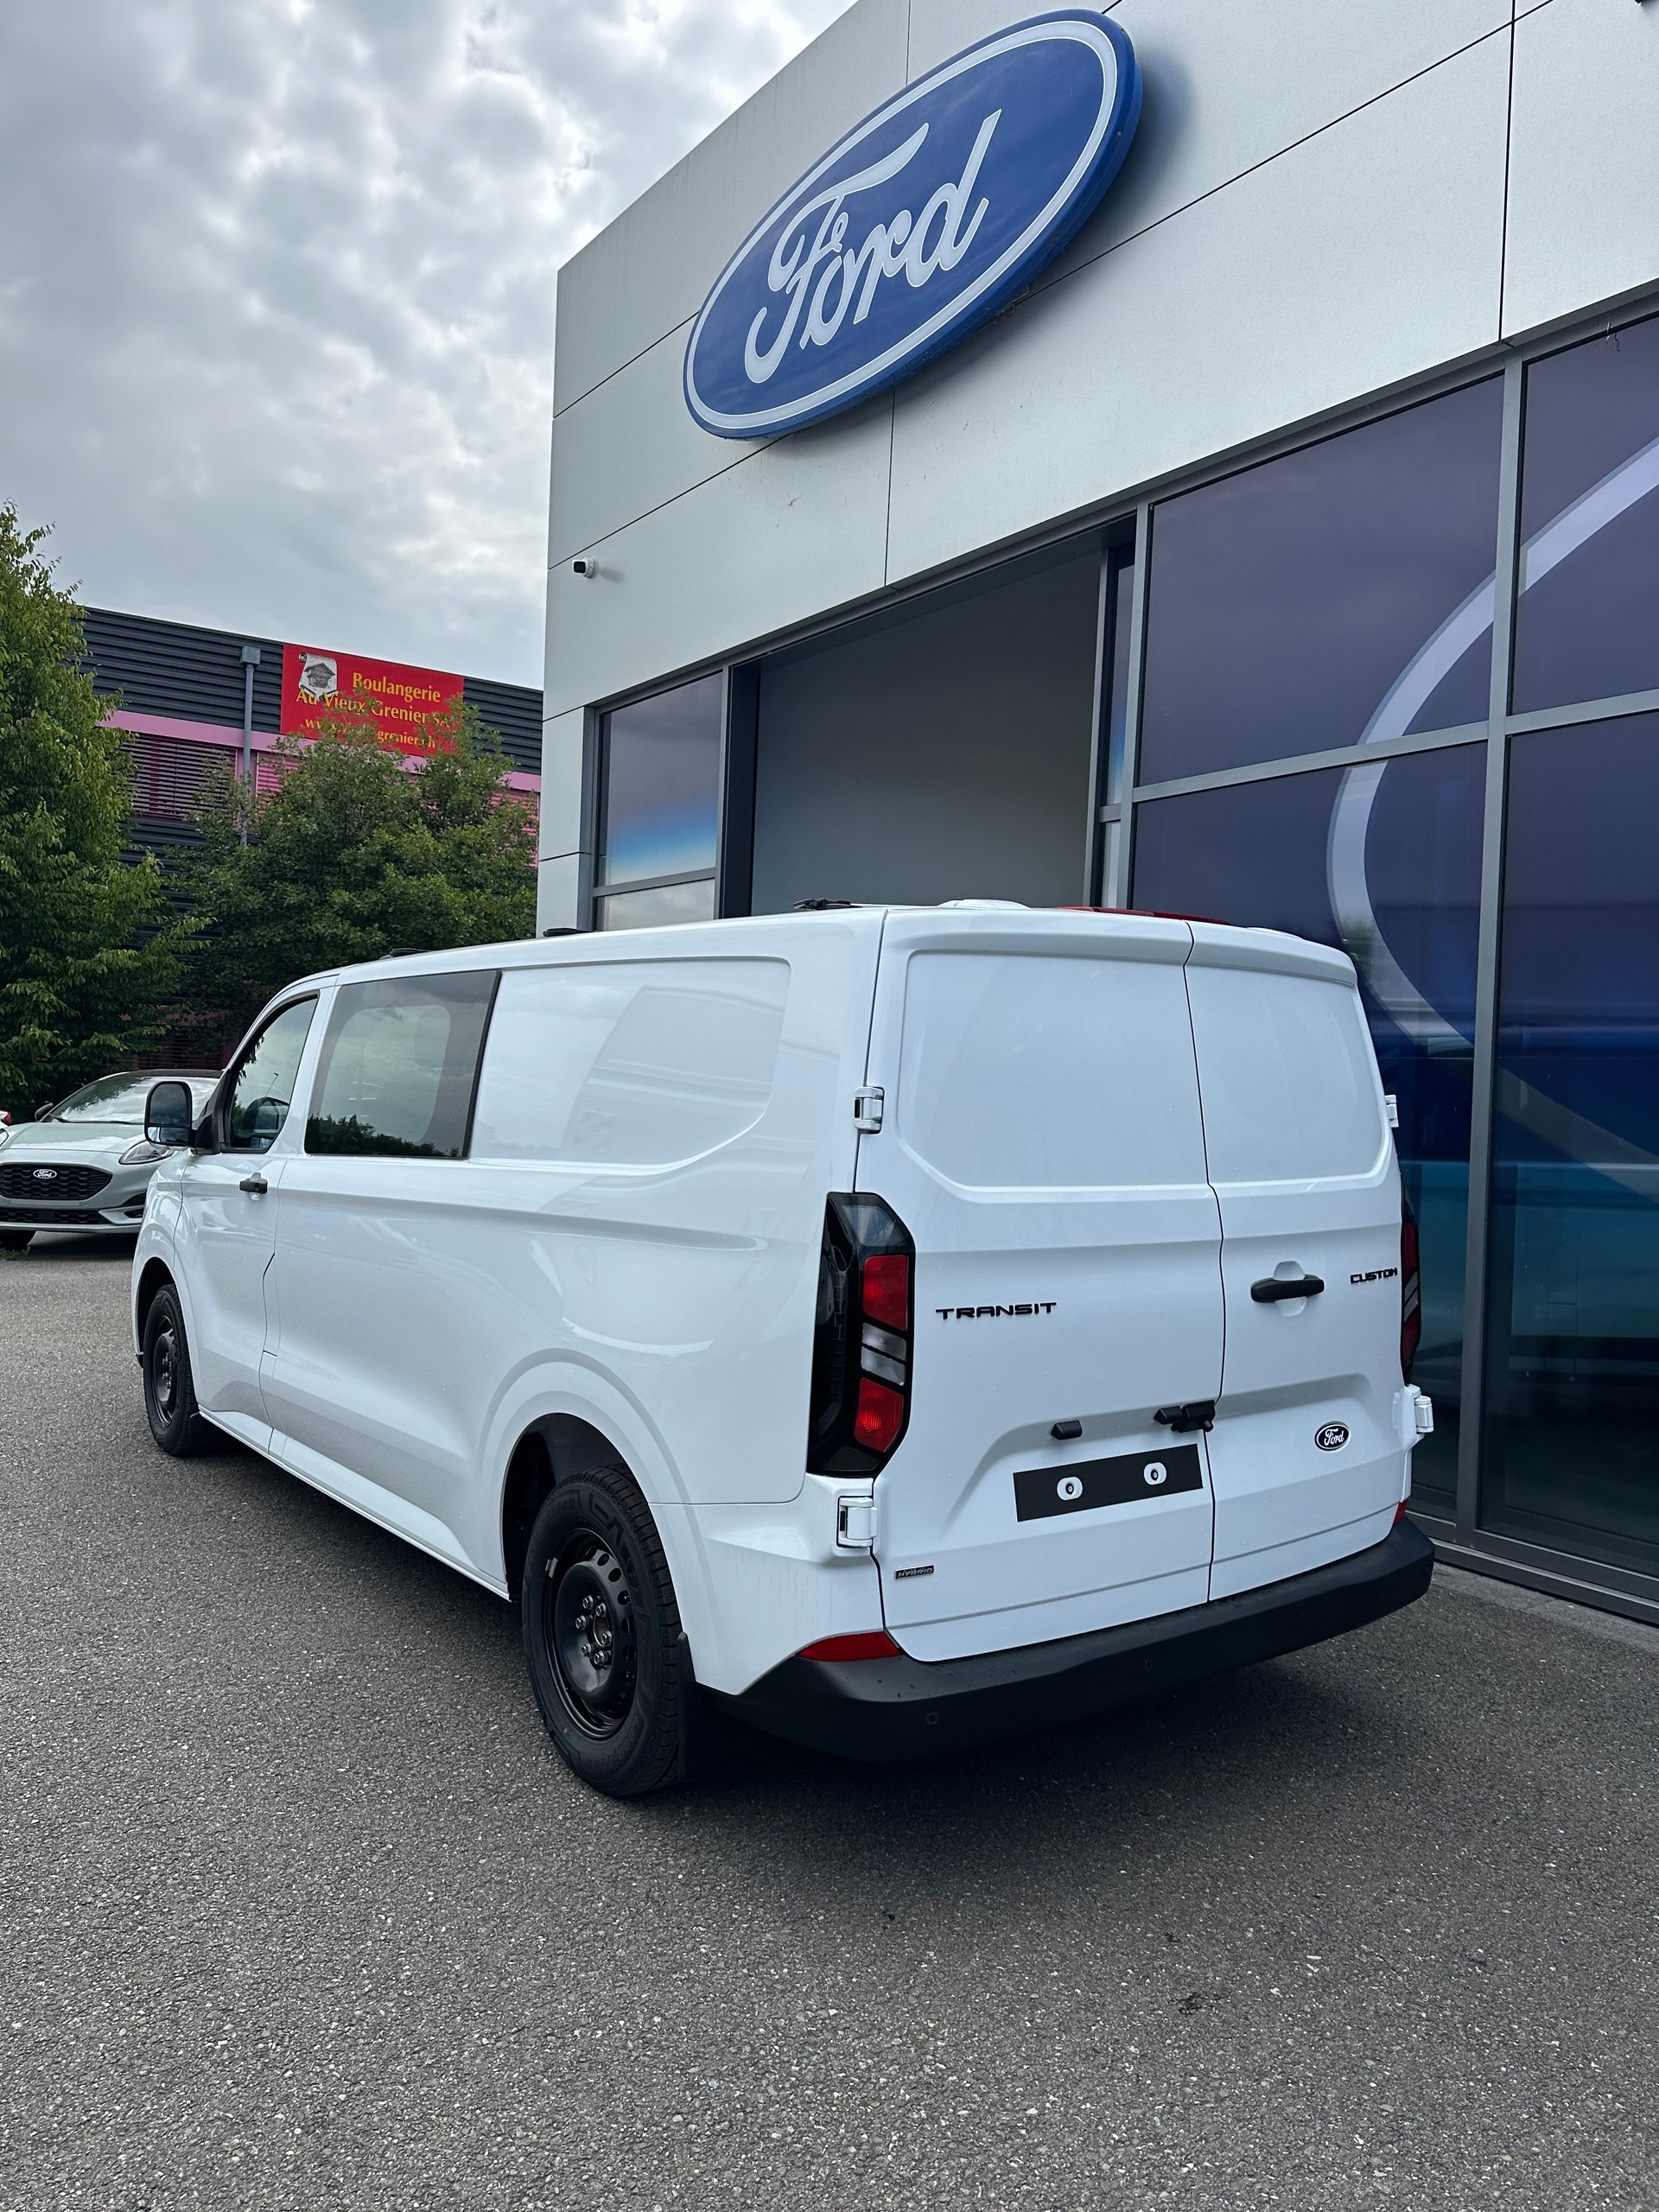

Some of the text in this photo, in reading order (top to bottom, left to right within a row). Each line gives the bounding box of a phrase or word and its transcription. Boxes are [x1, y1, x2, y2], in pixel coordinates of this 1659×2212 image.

[745, 109, 1001, 384] Ford
[353, 672, 442, 702] Boulangerie
[296, 687, 318, 705] Au
[371, 700, 426, 723] Grenier
[1351, 1268, 1398, 1284] CUSTOM
[936, 1302, 1057, 1319] TRANSIT
[1324, 1428, 1344, 1446] Ford
[898, 1567, 933, 1577] HYBRID
